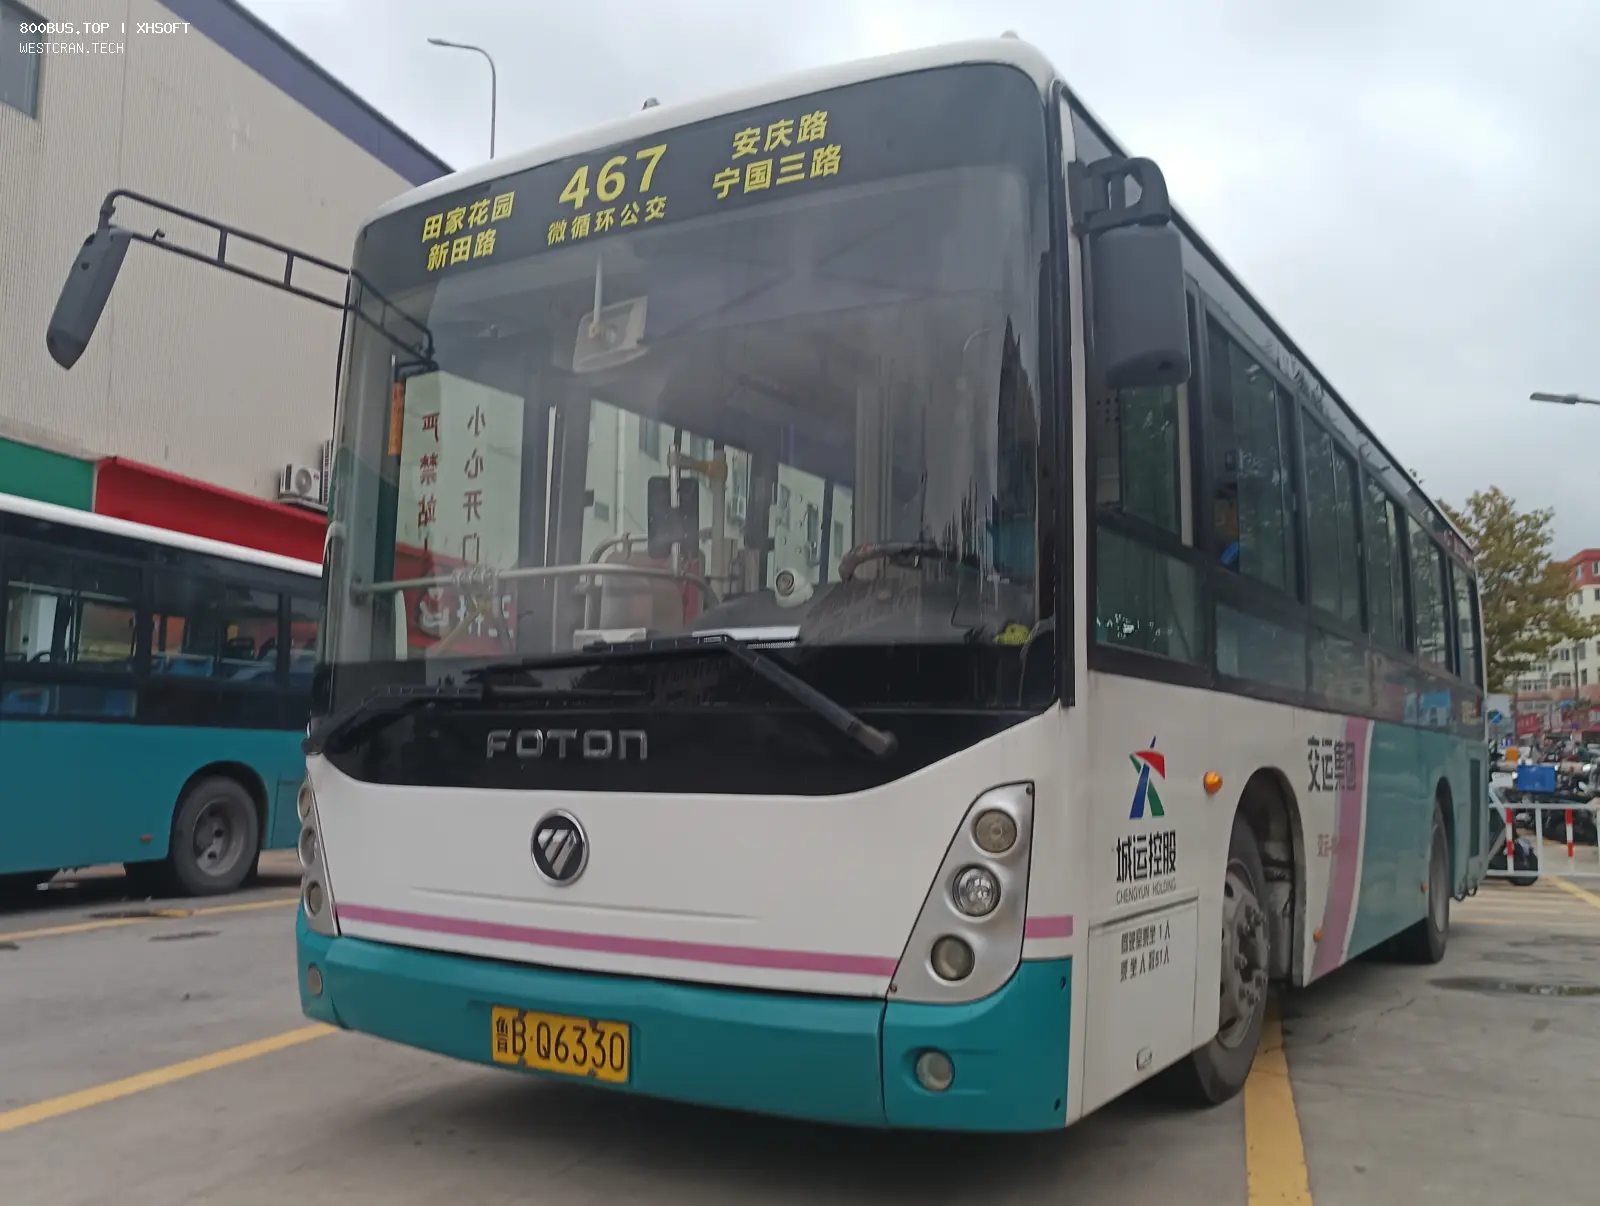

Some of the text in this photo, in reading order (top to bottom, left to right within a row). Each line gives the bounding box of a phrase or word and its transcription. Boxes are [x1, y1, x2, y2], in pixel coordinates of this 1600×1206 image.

[732, 110, 829, 160] 安庆路
[558, 143, 668, 211] 467
[711, 144, 842, 200] 宁国三路
[421, 191, 515, 242] 田家花园
[546, 196, 667, 246] 微循环公交
[426, 229, 497, 273] 新田路
[486, 728, 648, 760] FOTON
[1307, 735, 1356, 792] 交运集团
[1116, 829, 1177, 884] 城运控股
[1116, 877, 1177, 905] CHENGYUN HOLDING
